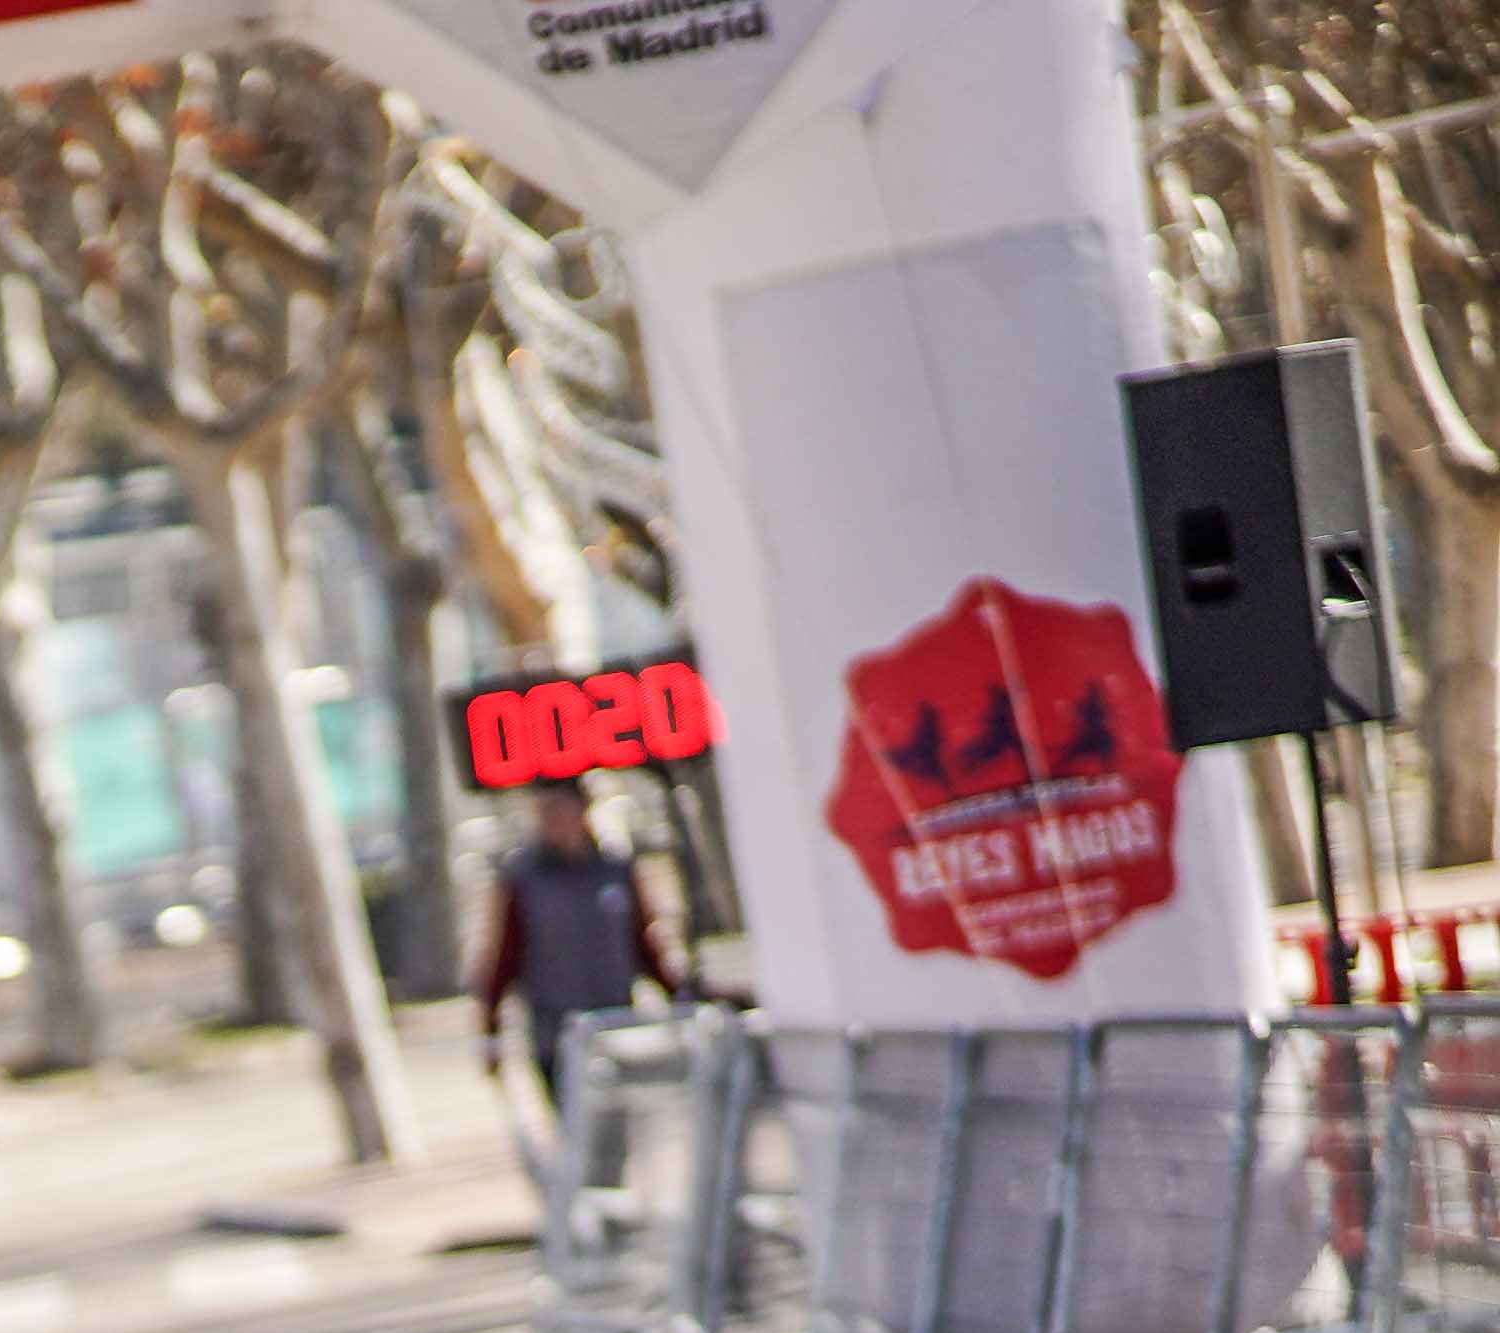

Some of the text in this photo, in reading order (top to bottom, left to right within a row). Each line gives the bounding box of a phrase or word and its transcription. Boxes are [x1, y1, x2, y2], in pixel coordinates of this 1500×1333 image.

[528, 0, 732, 39] Comun
[537, 2, 768, 73] de Madrid
